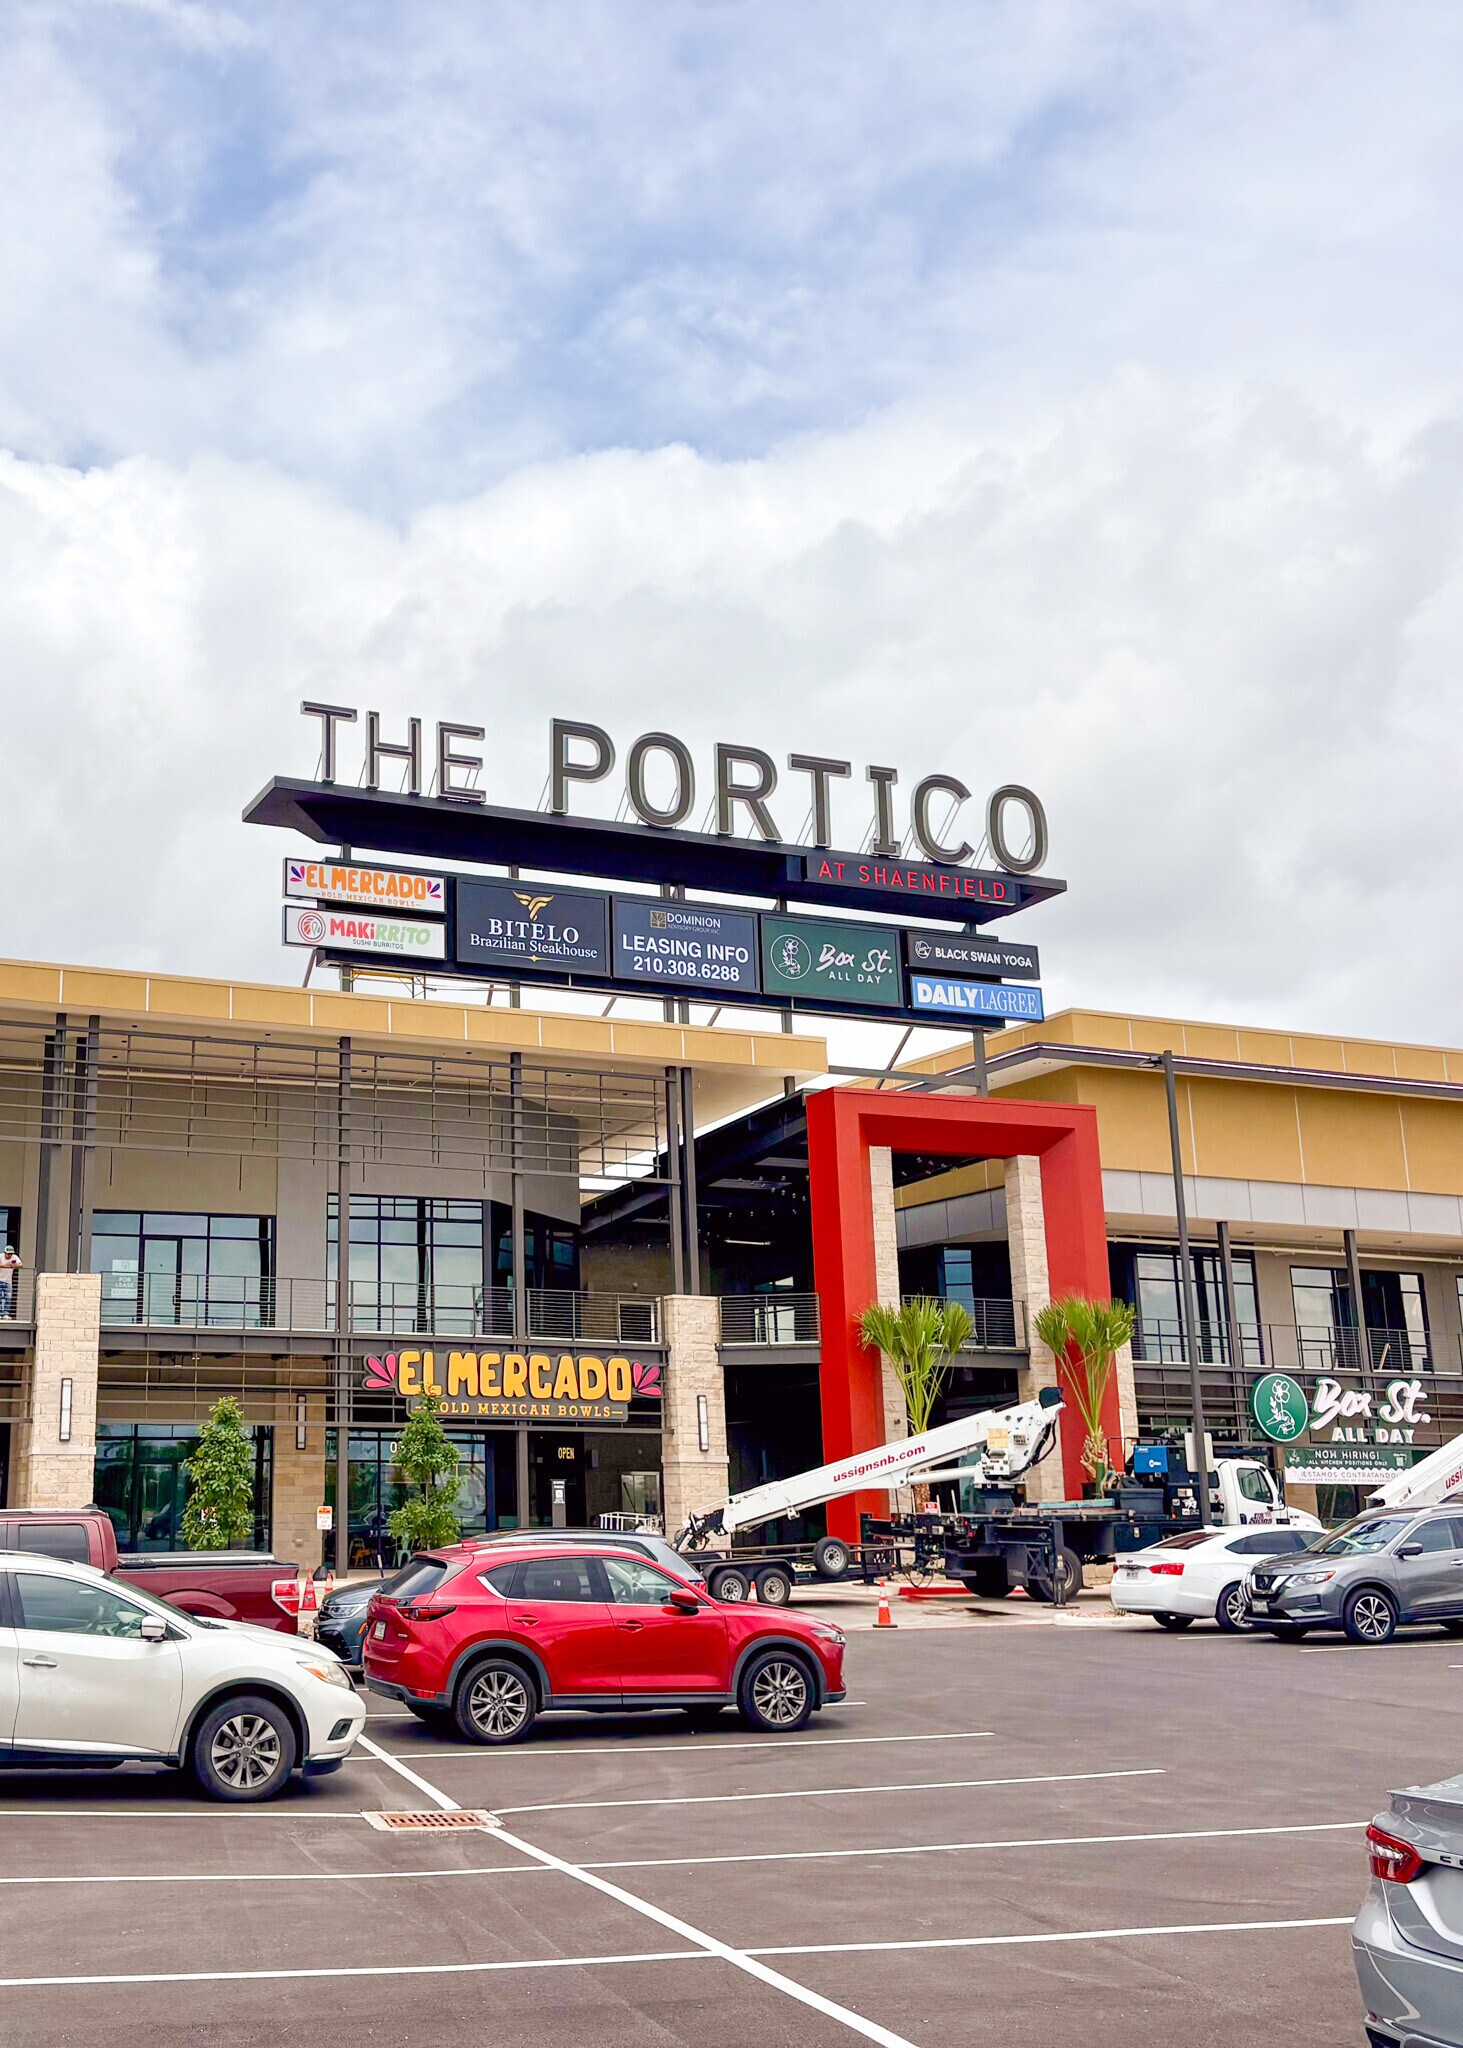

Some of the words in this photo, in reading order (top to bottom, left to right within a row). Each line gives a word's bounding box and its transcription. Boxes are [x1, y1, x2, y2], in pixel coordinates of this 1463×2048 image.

[301, 700, 487, 804] THE
[549, 717, 1049, 876] PORTICO
[306, 864, 329, 889] EL
[331, 867, 427, 901] MERCADO
[819, 860, 846, 880] AT
[858, 866, 1007, 900] SHAENFIELD
[321, 891, 343, 899] BOLD
[346, 894, 384, 904] MEXICAN
[388, 898, 415, 907] BOWLS
[488, 918, 579, 944] BITELO
[666, 912, 721, 929] DOMINION
[352, 938, 371, 947] SUSHI
[373, 940, 404, 950] BURRITOS
[470, 933, 526, 951] Brazilian
[529, 940, 598, 959] Steakhouse
[622, 934, 702, 959] LEASING
[707, 943, 749, 964] INFO
[633, 955, 740, 982] 210.308.6288
[816, 943, 855, 972] Box
[861, 949, 893, 974] St.
[935, 947, 969, 961] BLACK
[970, 951, 1001, 964] SWAN
[1002, 954, 1033, 968] YOGA
[828, 971, 851, 981] ALL
[857, 973, 881, 985] DAY
[398, 1350, 443, 1397] EL
[447, 1351, 632, 1403] MERCADO
[477, 1404, 551, 1417] MEXICAN
[557, 1405, 611, 1418] BOWLS
[1308, 1376, 1373, 1431] Box
[1378, 1378, 1432, 1425] St.
[1330, 1426, 1368, 1444] ALL
[1374, 1427, 1415, 1445] DAY
[557, 1447, 575, 1460] OPEN
[833, 1445, 926, 1483] ussignsnb.com
[1315, 1450, 1337, 1459] NOW
[1341, 1450, 1380, 1460] HIRING!
